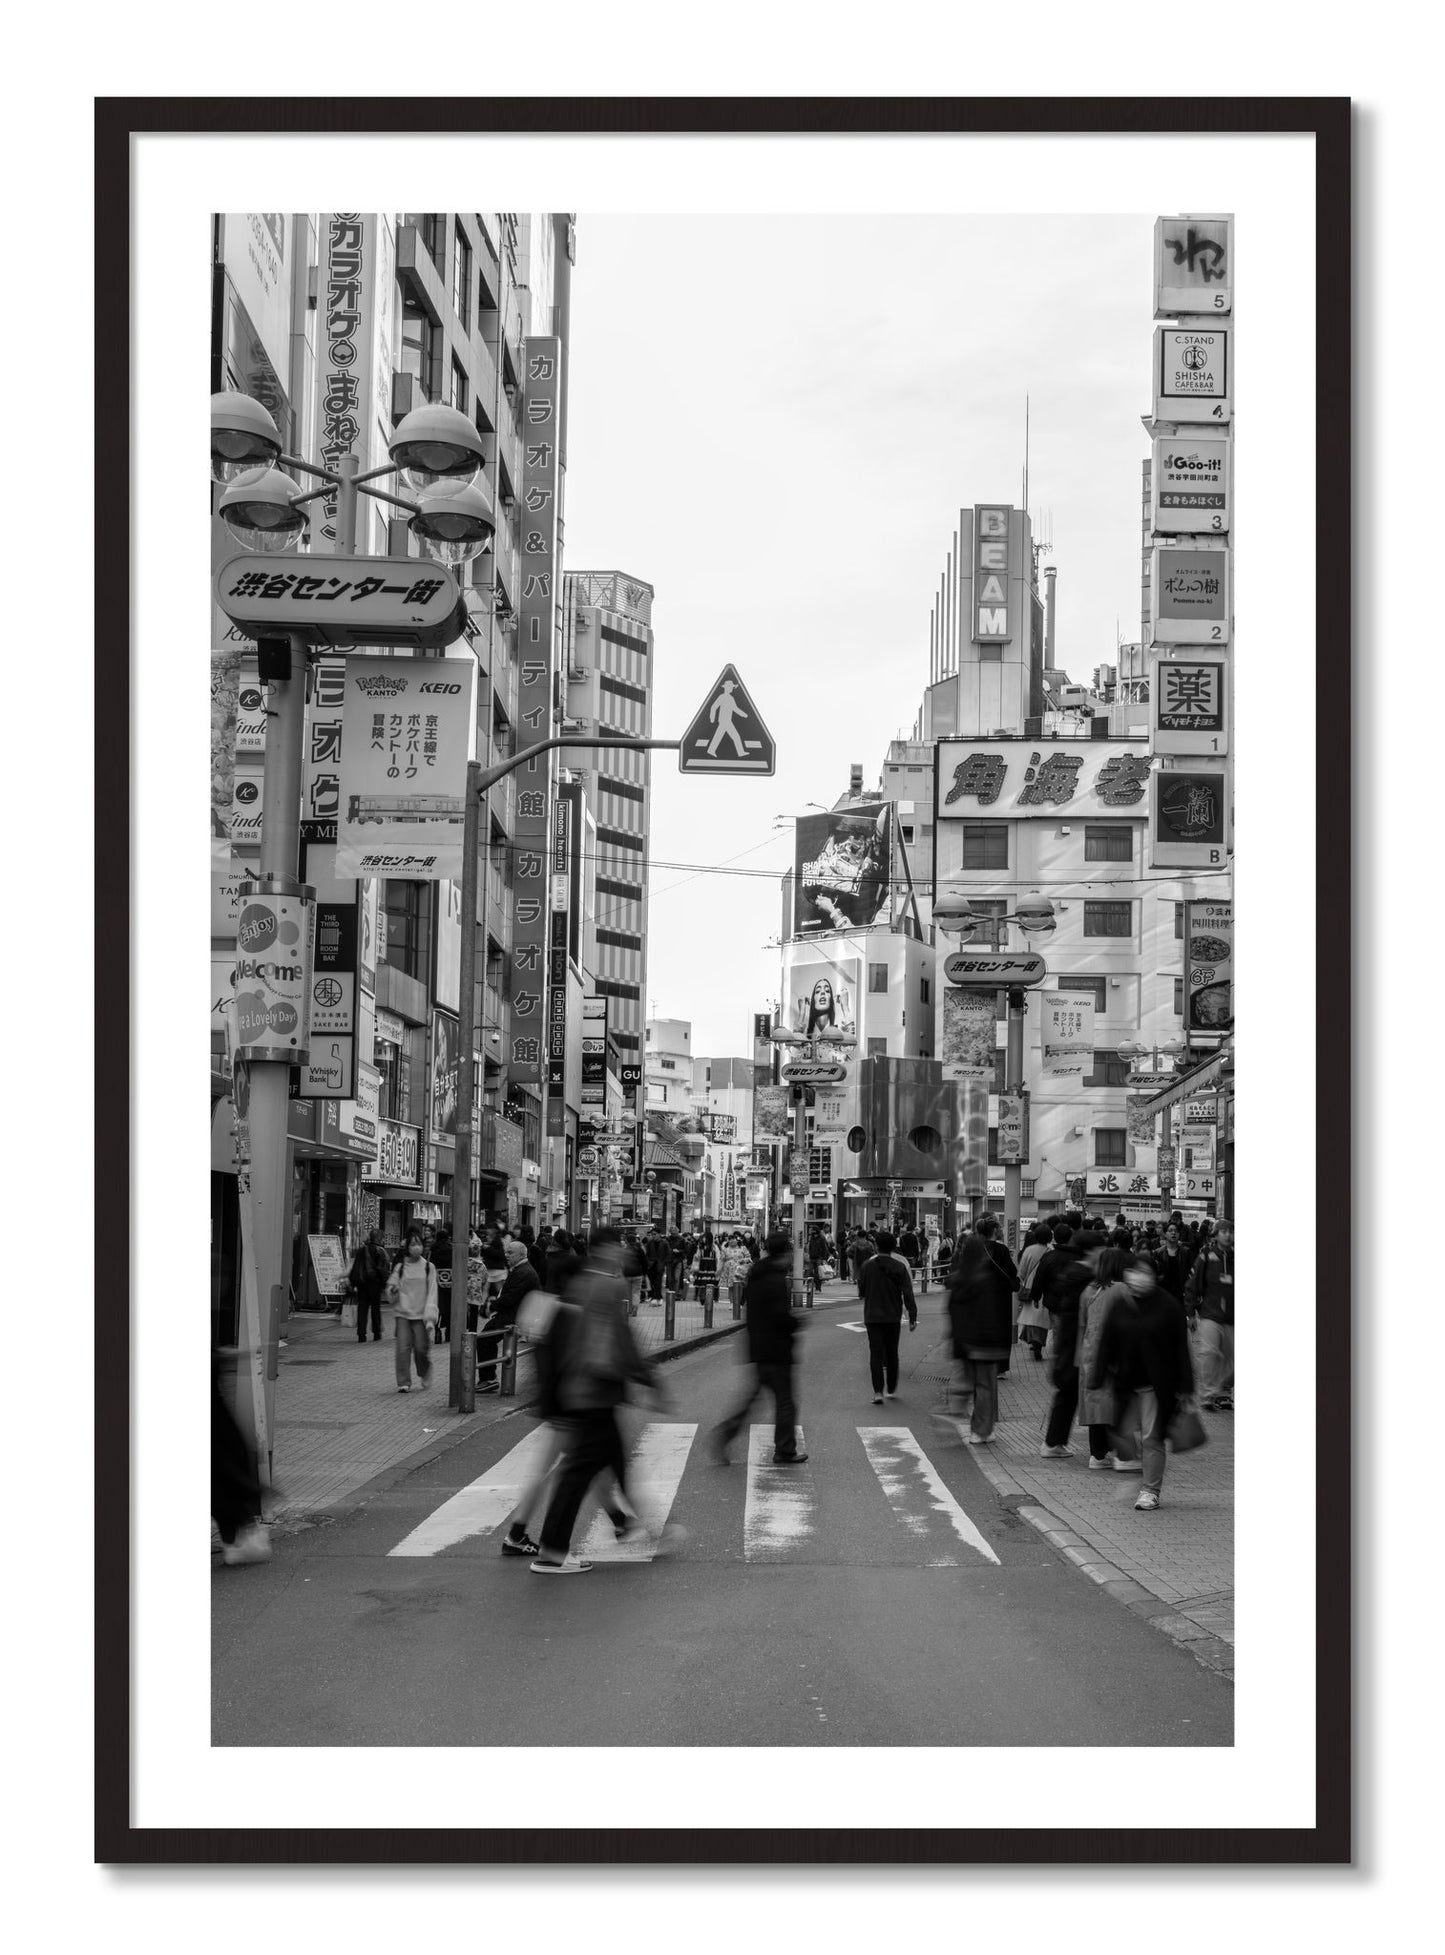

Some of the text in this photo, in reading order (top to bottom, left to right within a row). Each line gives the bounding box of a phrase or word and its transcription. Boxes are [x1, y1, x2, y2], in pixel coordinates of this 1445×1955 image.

[326, 220, 364, 340] カラオケ
[1213, 294, 1225, 309] 5
[1174, 336, 1215, 345] C.STAND
[1174, 371, 1214, 381] SHISHA
[1174, 456, 1222, 471] Goo-it!
[1163, 495, 1223, 506] 全身もみほぐし
[1211, 515, 1223, 530] 3
[978, 508, 1008, 636] BEAM
[228, 572, 446, 605] 渋谷センター街
[1164, 577, 1220, 595] ポムの樹
[1211, 626, 1222, 640] 2
[419, 682, 462, 695] KEIO
[1166, 668, 1211, 713] 薬
[1162, 715, 1216, 728] マツモトキヨシ
[371, 713, 385, 751] 冒険へ
[240, 738, 262, 746] 渋谷店
[386, 713, 402, 779] カントーの
[404, 713, 421, 779] ポケパーク
[423, 714, 439, 767] 京王線で
[1210, 737, 1218, 752] 1
[944, 752, 1151, 806] 角海老
[1161, 786, 1215, 829] 一蘭
[557, 804, 565, 835] kimono
[236, 831, 259, 839] 渋谷店
[359, 855, 438, 867] 渋谷センター街
[1209, 849, 1220, 864] B
[239, 915, 275, 945] Enjoy
[322, 954, 336, 962] BAR
[512, 852, 544, 1064] カラオケ館
[237, 958, 303, 982] Welcome
[950, 960, 1041, 973] 渋谷センター街
[1190, 968, 1216, 986] 6F
[251, 1009, 278, 1027] Lovely
[279, 1010, 297, 1024] Day!
[309, 1066, 339, 1077] Whisky
[309, 1075, 328, 1083] Bank
[623, 1070, 641, 1080] GU
[726, 1172, 734, 1210] BEER
[1098, 1173, 1151, 1193] 兆楽
